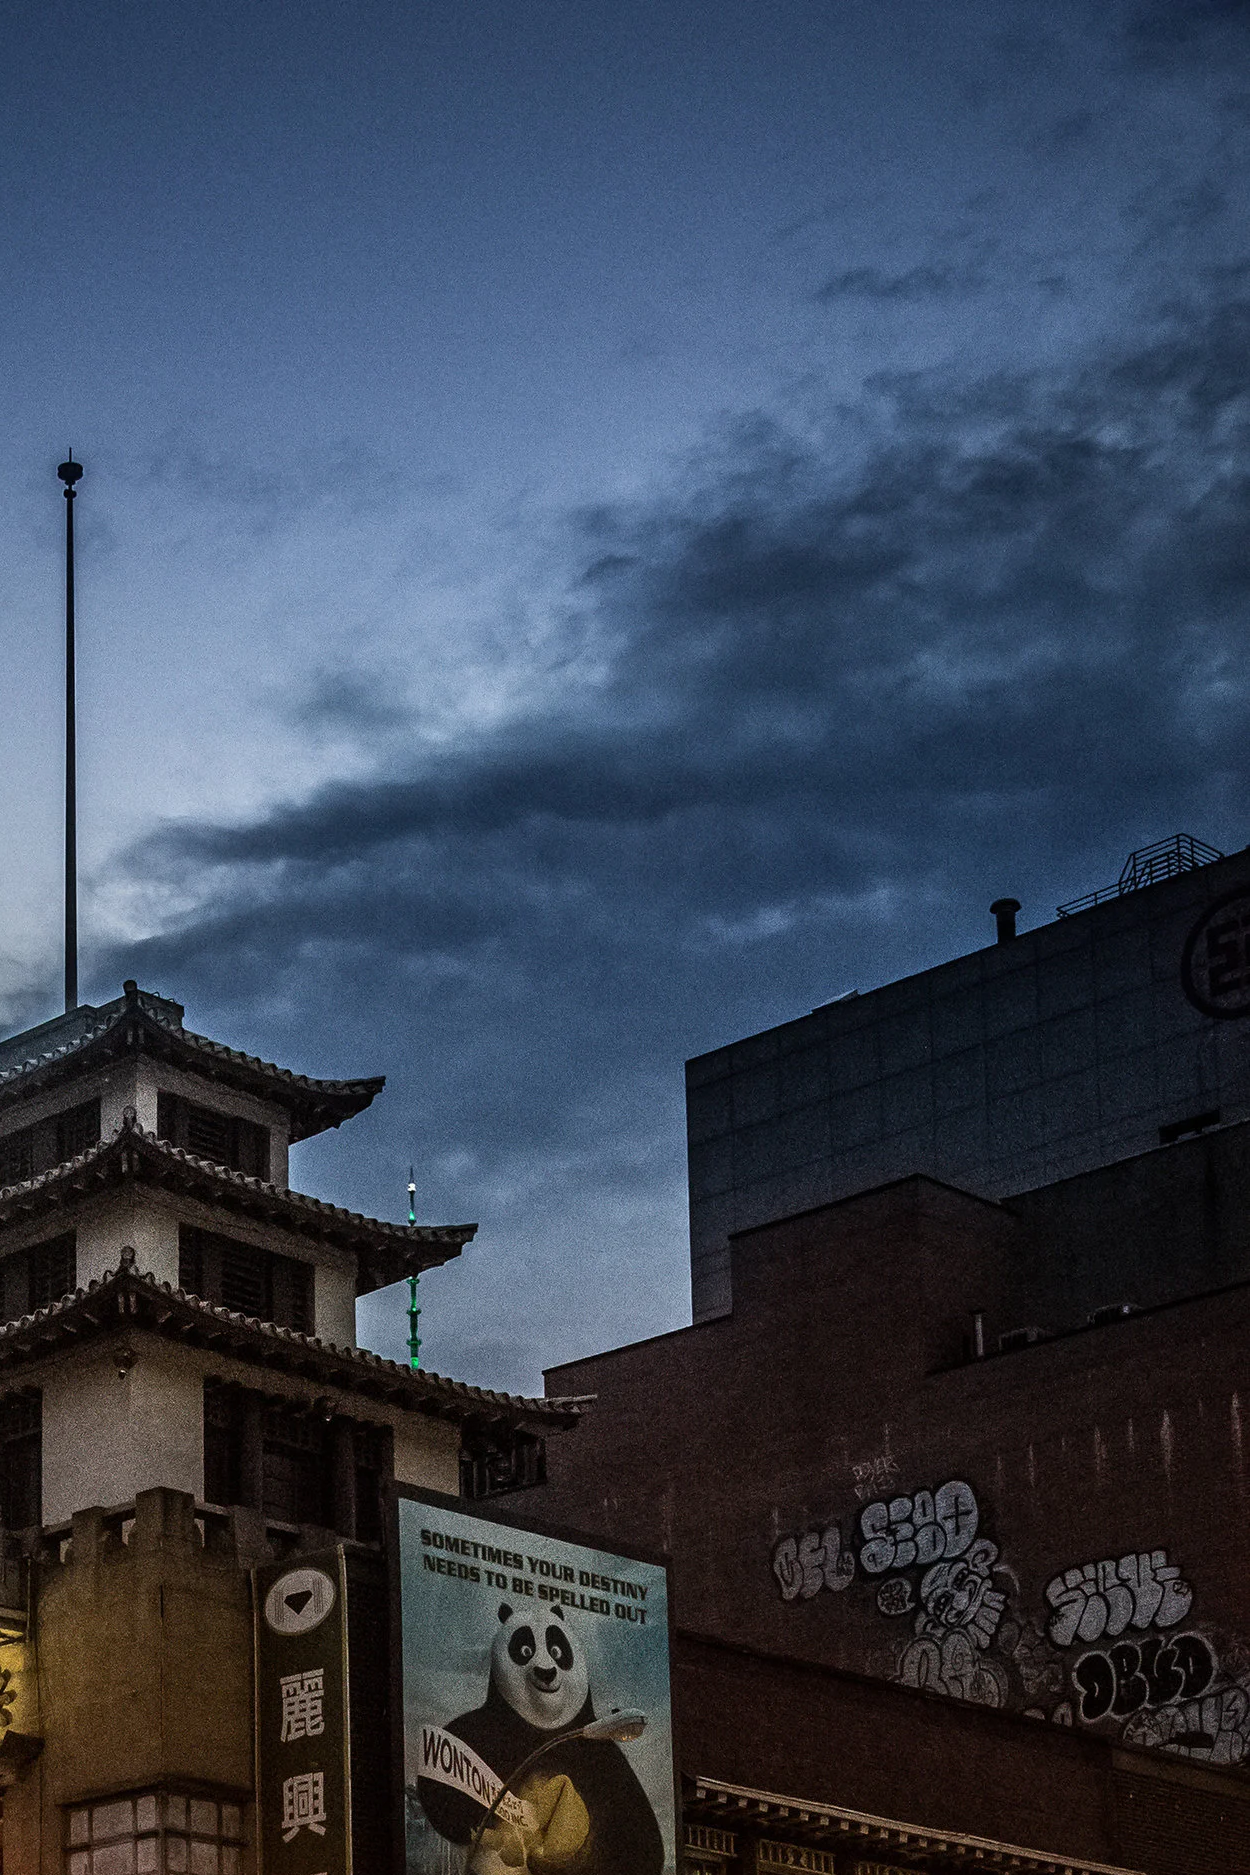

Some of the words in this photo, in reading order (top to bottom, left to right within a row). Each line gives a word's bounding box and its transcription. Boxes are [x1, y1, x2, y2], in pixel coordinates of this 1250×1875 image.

[421, 1529, 523, 1570] SOMETIMES
[525, 1555, 574, 1583] YOUR
[579, 1571, 649, 1601] DESTINY
[423, 1554, 480, 1582] NEEDS
[484, 1569, 507, 1590] TO
[512, 1578, 534, 1597] BE
[538, 1584, 610, 1616] SPELLED
[614, 1605, 648, 1625] OUT
[423, 1728, 492, 1806] WONTON
